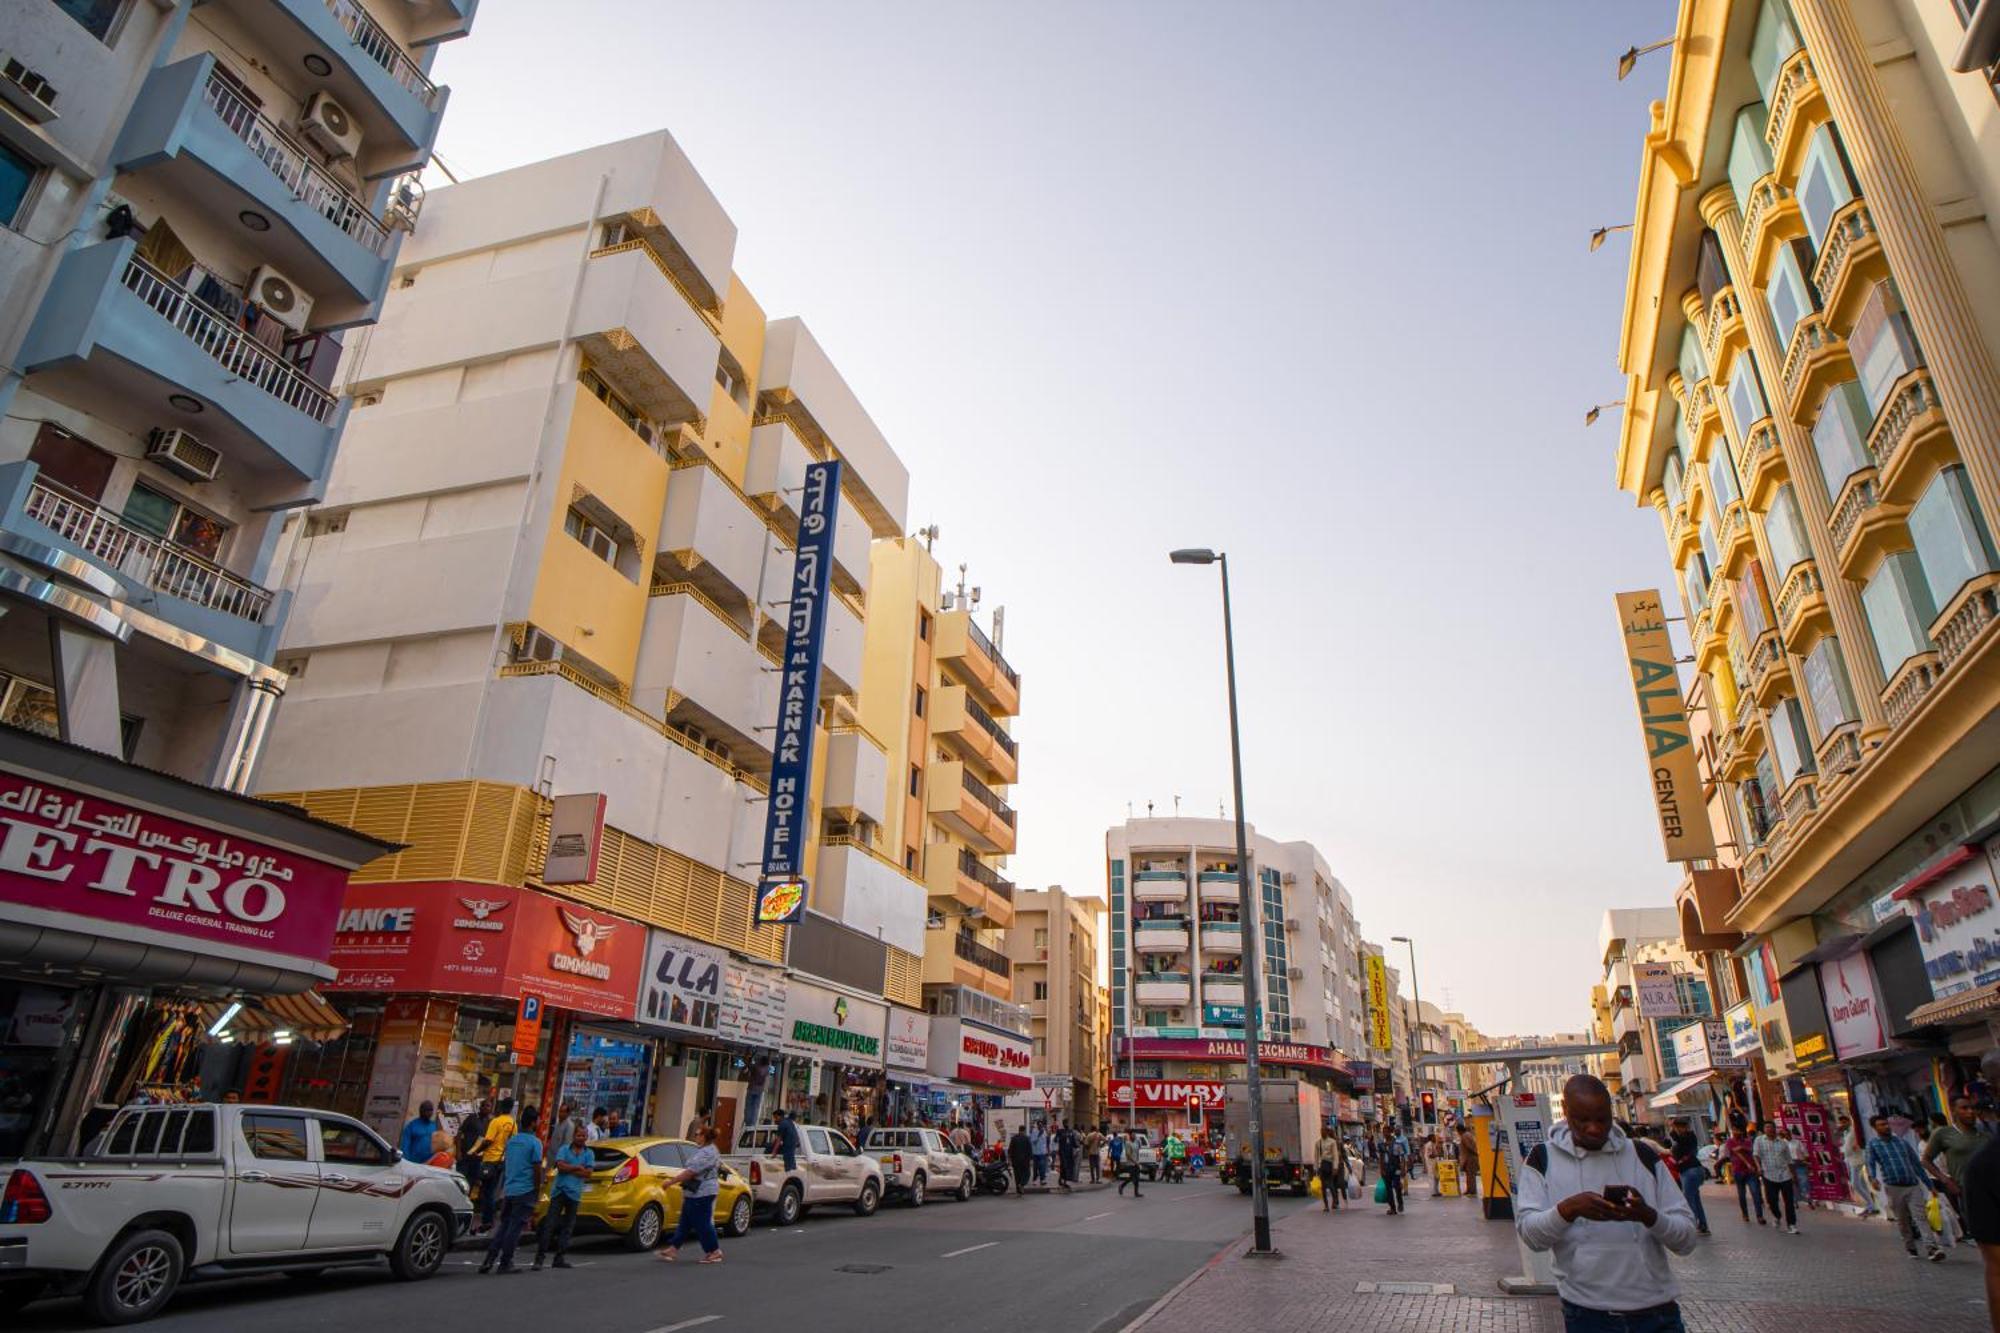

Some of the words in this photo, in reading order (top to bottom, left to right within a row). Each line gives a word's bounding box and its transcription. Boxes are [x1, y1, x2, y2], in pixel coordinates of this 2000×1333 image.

[803, 467, 828, 535] فندق
[793, 545, 819, 638] الكرنك
[1632, 602, 1659, 613] مركز
[1625, 619, 1664, 635] علياء
[791, 652, 809, 664] AL
[780, 670, 807, 764] KARNAK
[1631, 657, 1690, 760] ALIA
[40, 794, 142, 839] للتجارة
[771, 777, 796, 860] HOTEL
[1653, 766, 1683, 840] CENTER
[138, 830, 245, 869] ديلوكس
[0, 816, 286, 923] ETRO
[243, 855, 294, 882] مترو
[149, 907, 183, 921] DELUXE
[185, 914, 223, 929] GENERAL
[225, 921, 258, 936] TRADING
[259, 928, 275, 939] LLC
[552, 952, 611, 980] COMMANDO
[525, 998, 537, 1019] P
[1208, 1041, 1245, 1055] AHALI
[1257, 1042, 1309, 1059] EXCHANGE
[1143, 1084, 1226, 1102] VIMBY
